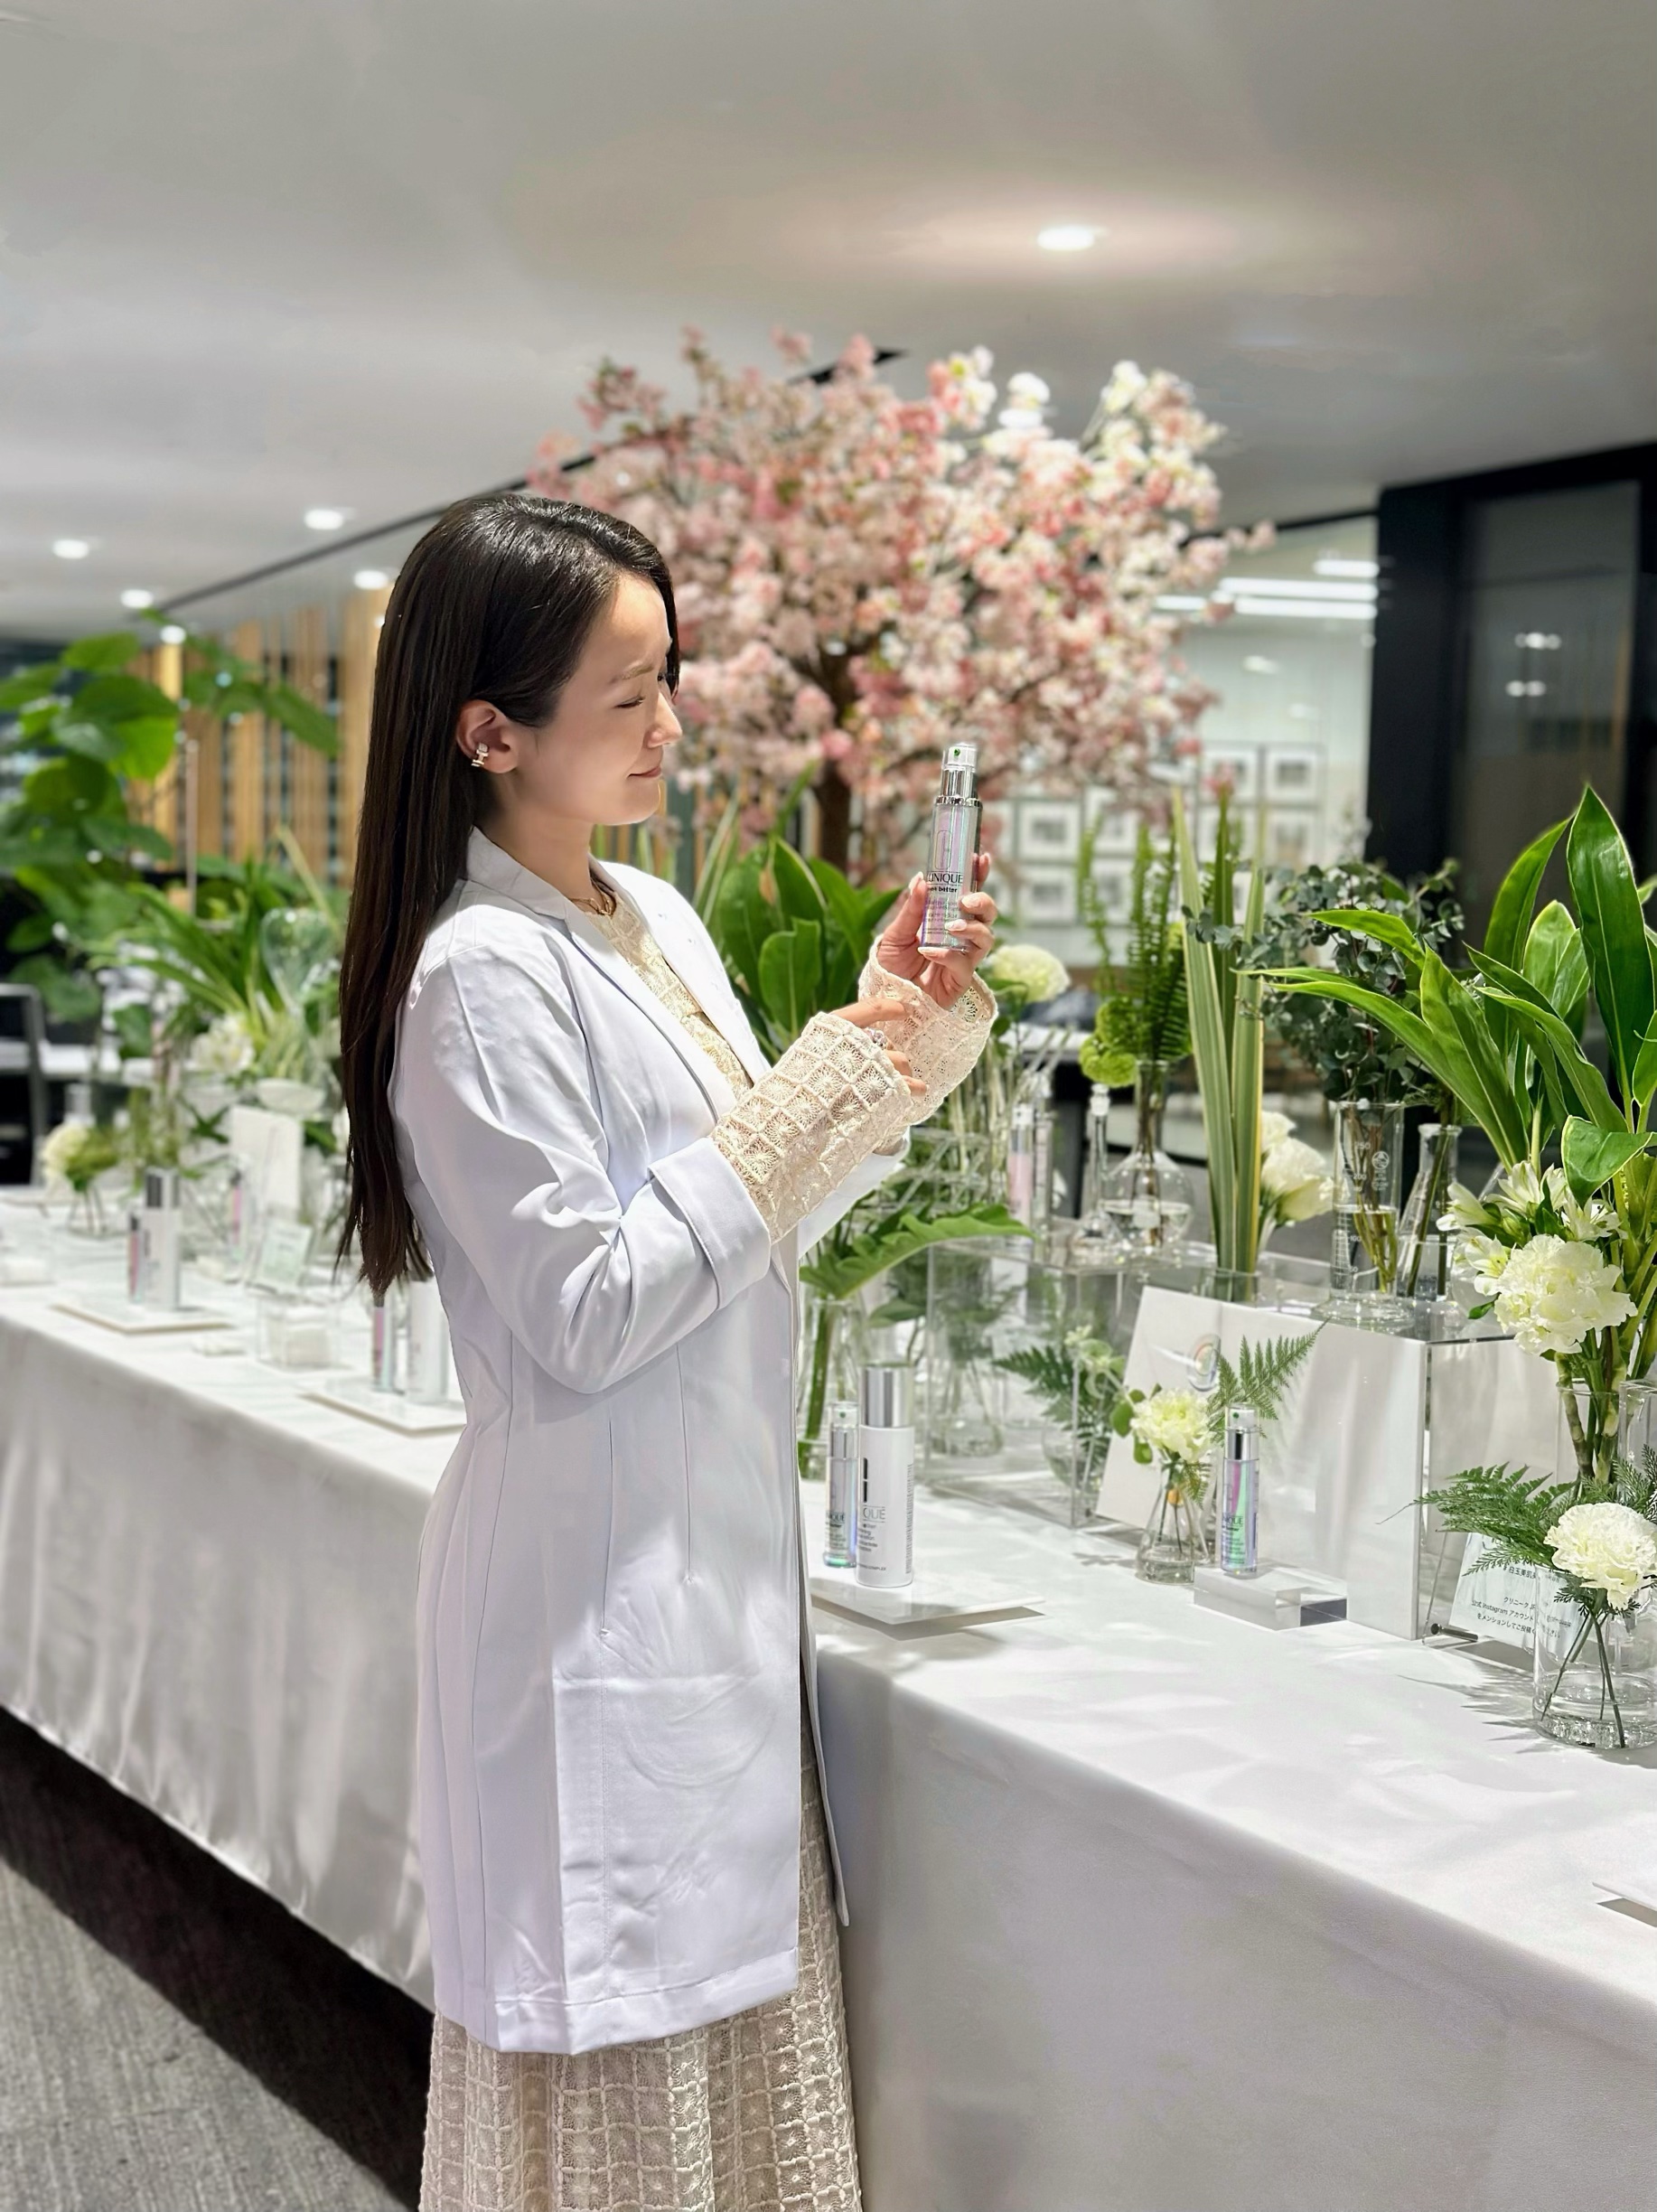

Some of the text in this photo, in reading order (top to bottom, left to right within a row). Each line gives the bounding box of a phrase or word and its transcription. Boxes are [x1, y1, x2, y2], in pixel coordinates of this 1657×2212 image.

[928, 873, 963, 884] LINIQUE
[1503, 1596, 1530, 1608] クリニーク
[1482, 1602, 1509, 1616] Instagram
[1508, 1609, 1534, 1622] アカウント
